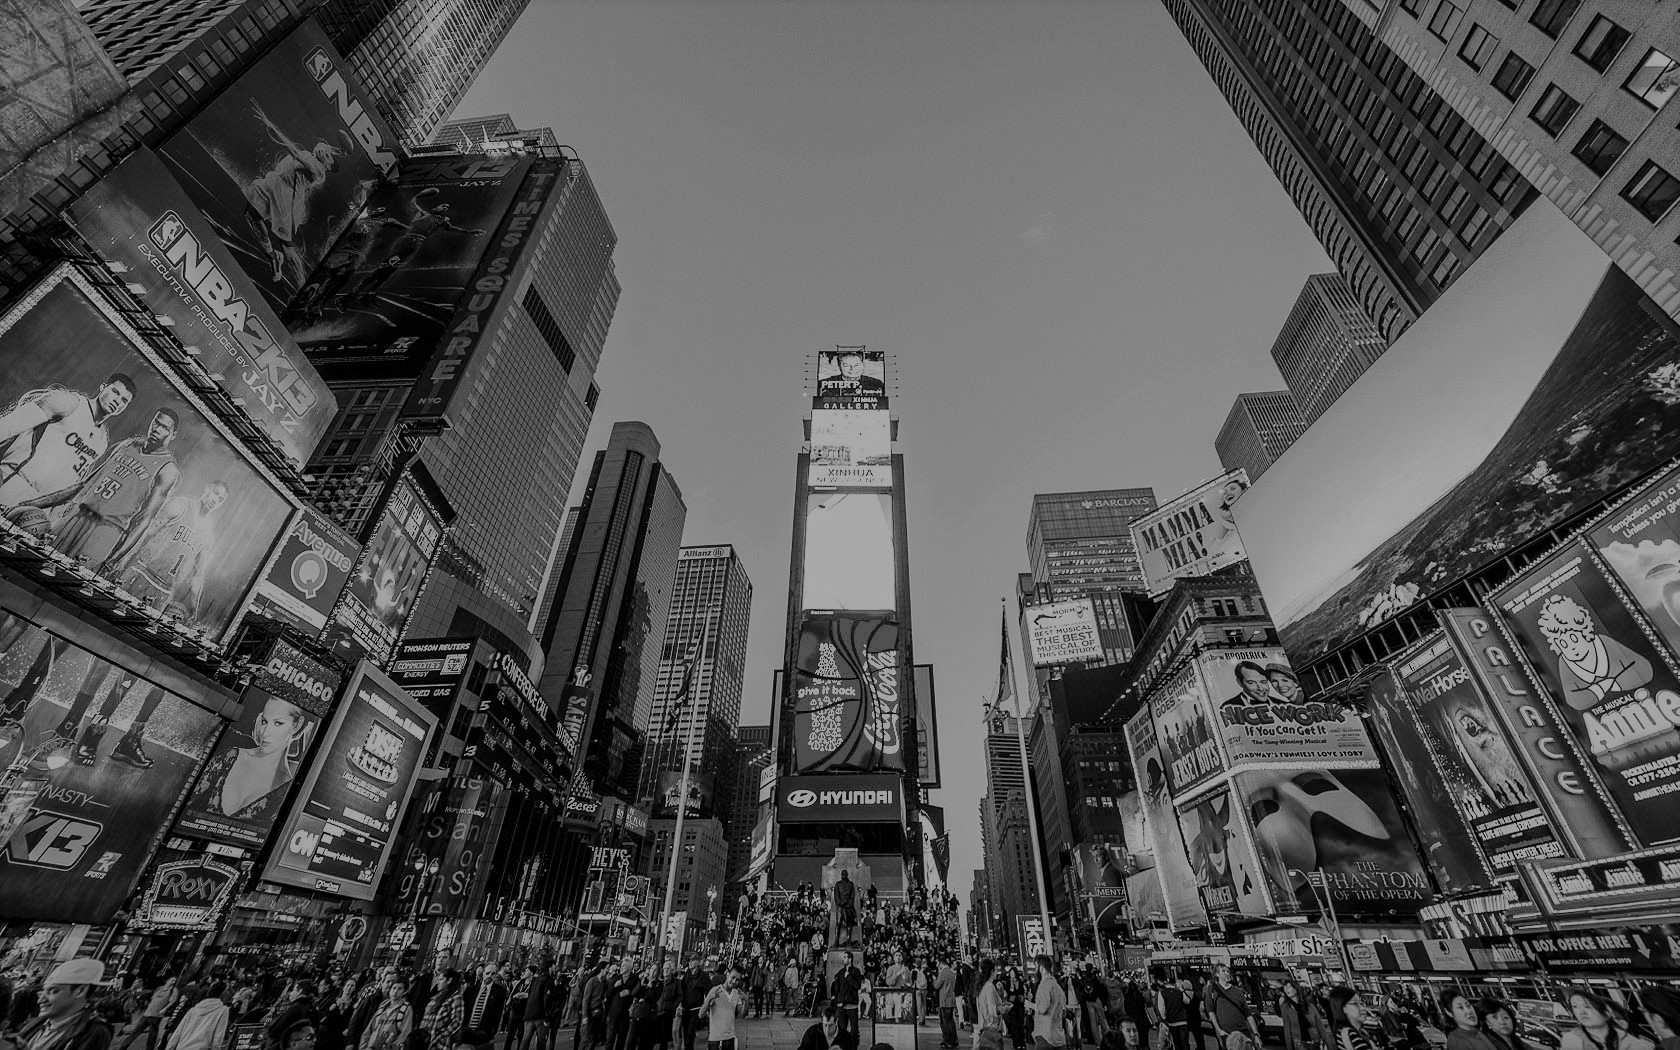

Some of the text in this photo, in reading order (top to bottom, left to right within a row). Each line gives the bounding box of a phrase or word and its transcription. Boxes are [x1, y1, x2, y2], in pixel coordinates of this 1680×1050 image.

[321, 71, 400, 178] NBA
[430, 172, 555, 380] TIMES SQUARE
[137, 243, 300, 435] EXECUTIVE PRODUCED BY JAY Z
[821, 380, 852, 388] PETER
[417, 397, 442, 405] NYC
[828, 468, 874, 476] XINHUA
[93, 475, 123, 500] 35
[1095, 496, 1149, 508] BARCLAYS
[1607, 504, 1651, 534] Temptation
[1647, 490, 1668, 507] isn't
[1140, 501, 1215, 554] MAMMA
[1622, 518, 1650, 539] Unless
[1648, 508, 1666, 525] you
[291, 520, 352, 573] Avenue
[1161, 531, 1208, 573] MIA!
[290, 550, 328, 600] Q
[1034, 629, 1053, 638] BEST
[1056, 625, 1093, 634] MUSICAL
[1035, 630, 1093, 646] THE BEST
[403, 643, 471, 653] THOMSON REUTERS
[1037, 639, 1095, 653] MUSICAL OF
[1224, 650, 1268, 660] BRODERICK
[267, 657, 333, 702] CHICAGO
[501, 653, 539, 709] CONFERENCE
[535, 696, 549, 721] CALL
[433, 688, 451, 696] GAS
[797, 685, 856, 698] give it back
[863, 647, 899, 755] Coca-Cola
[1155, 698, 1176, 718] GOES
[1220, 702, 1346, 728] NICE WORK
[1470, 617, 1585, 795] PALACE
[1591, 694, 1634, 715] THE MUSICAL
[1245, 725, 1327, 737] If You Can Get It
[1582, 687, 1680, 754] Annie
[1171, 738, 1220, 789] JERSEY BOYS
[820, 790, 893, 806] HYUNDAI
[591, 846, 628, 868] HEY'S
[1353, 861, 1381, 871] THE
[84, 870, 107, 880] SPORTS
[1334, 889, 1423, 900] OF THE OPERA
[1531, 934, 1631, 952] BOX OFFICE HERE
